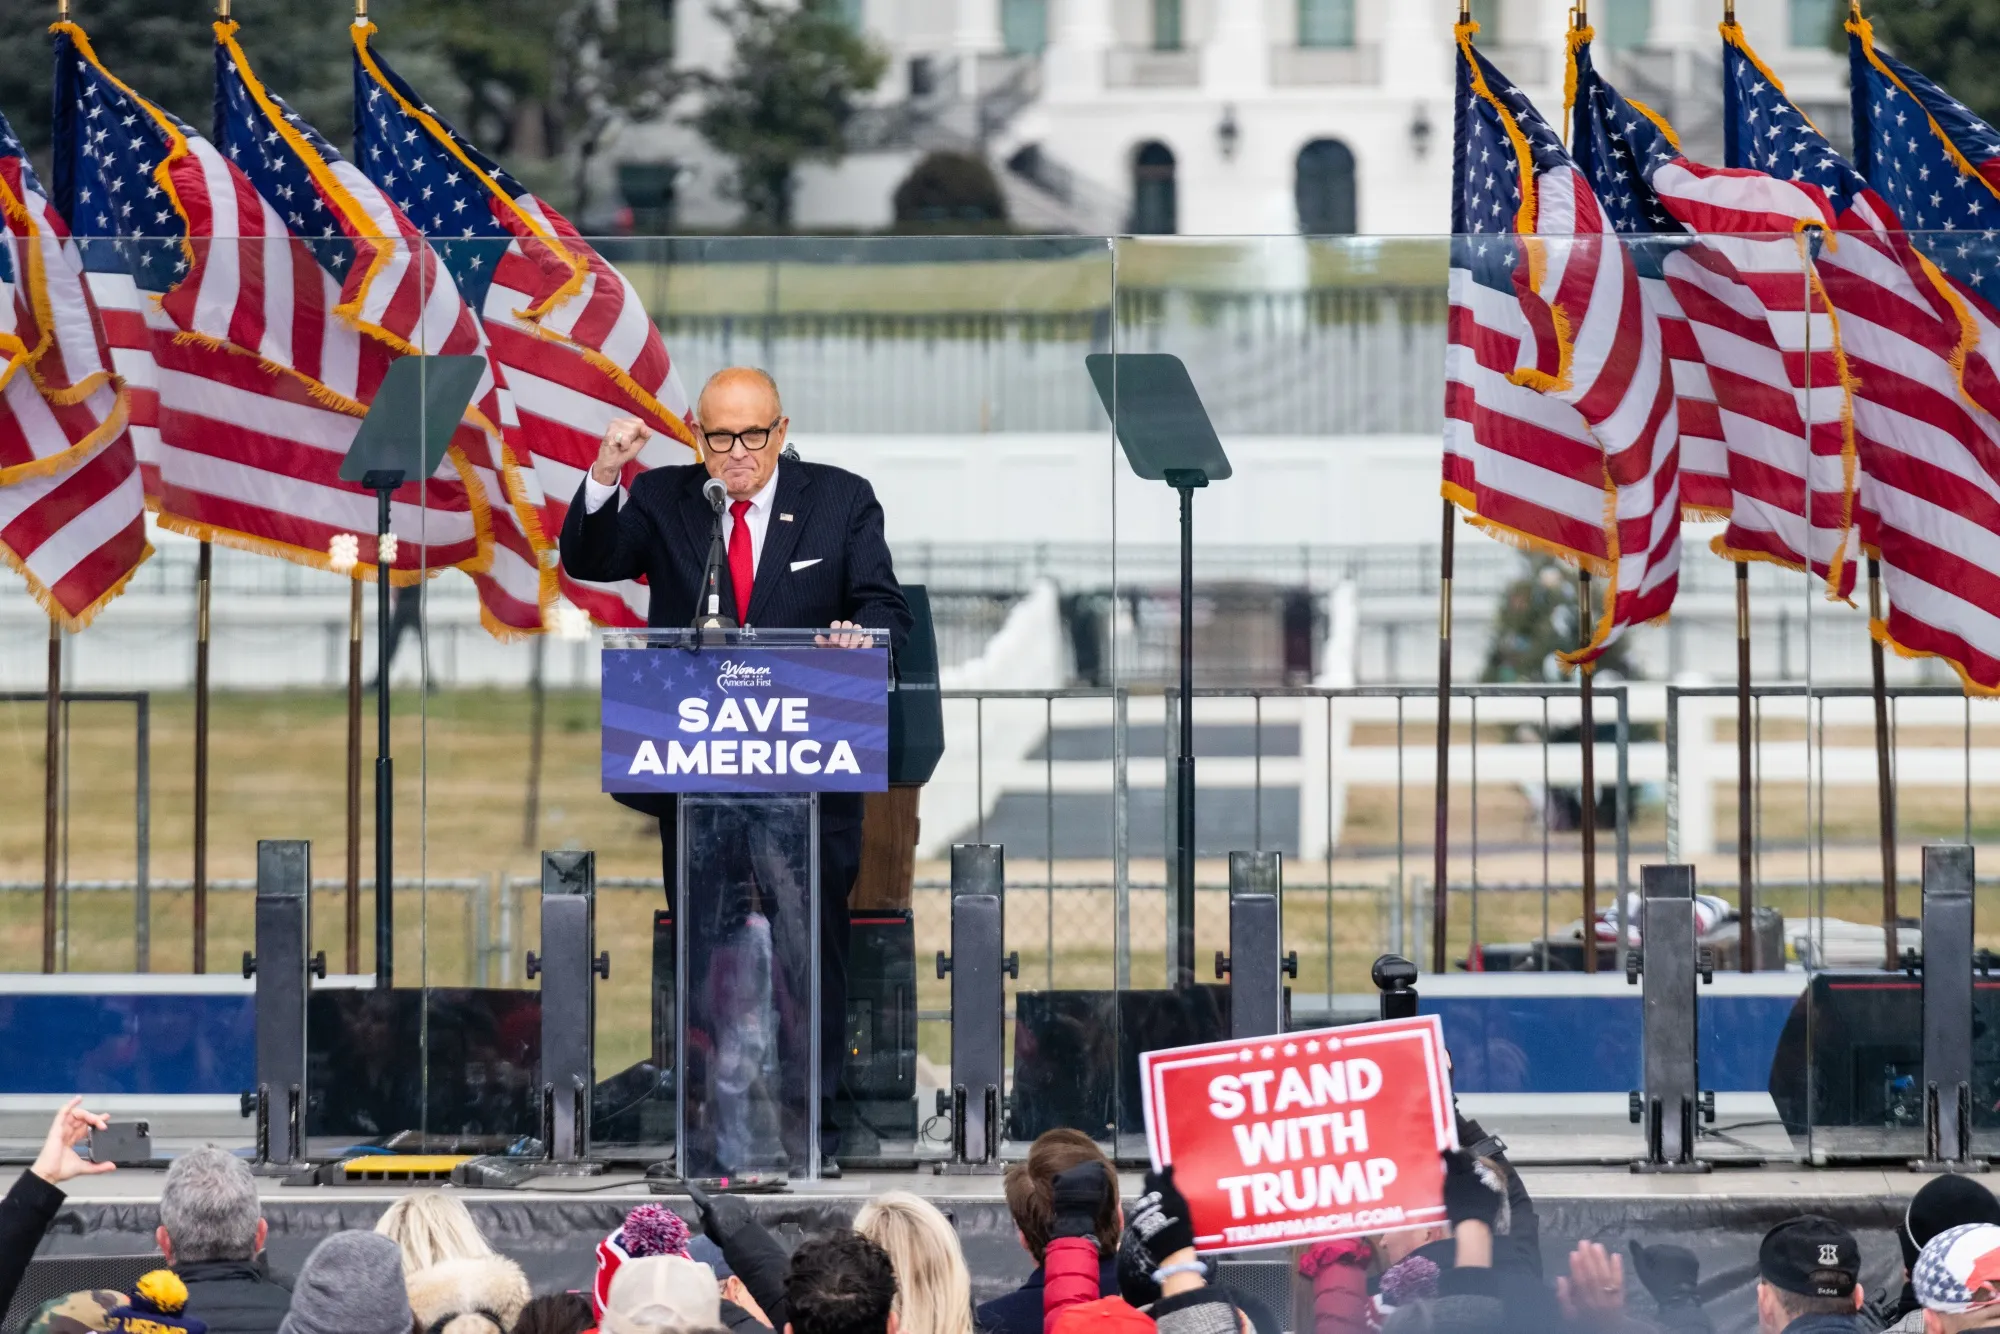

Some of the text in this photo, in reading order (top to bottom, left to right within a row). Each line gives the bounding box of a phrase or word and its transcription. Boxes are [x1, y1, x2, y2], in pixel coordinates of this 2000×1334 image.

[720, 660, 772, 675] Women
[723, 678, 771, 686] America First
[677, 697, 809, 732] SAVE
[628, 739, 861, 775] AMERICA
[1208, 1057, 1383, 1119] STAND
[1232, 1109, 1369, 1166] WITH
[1217, 1157, 1397, 1219] TRUMP
[1222, 1206, 1405, 1243] TRUMPMARCH.COM
